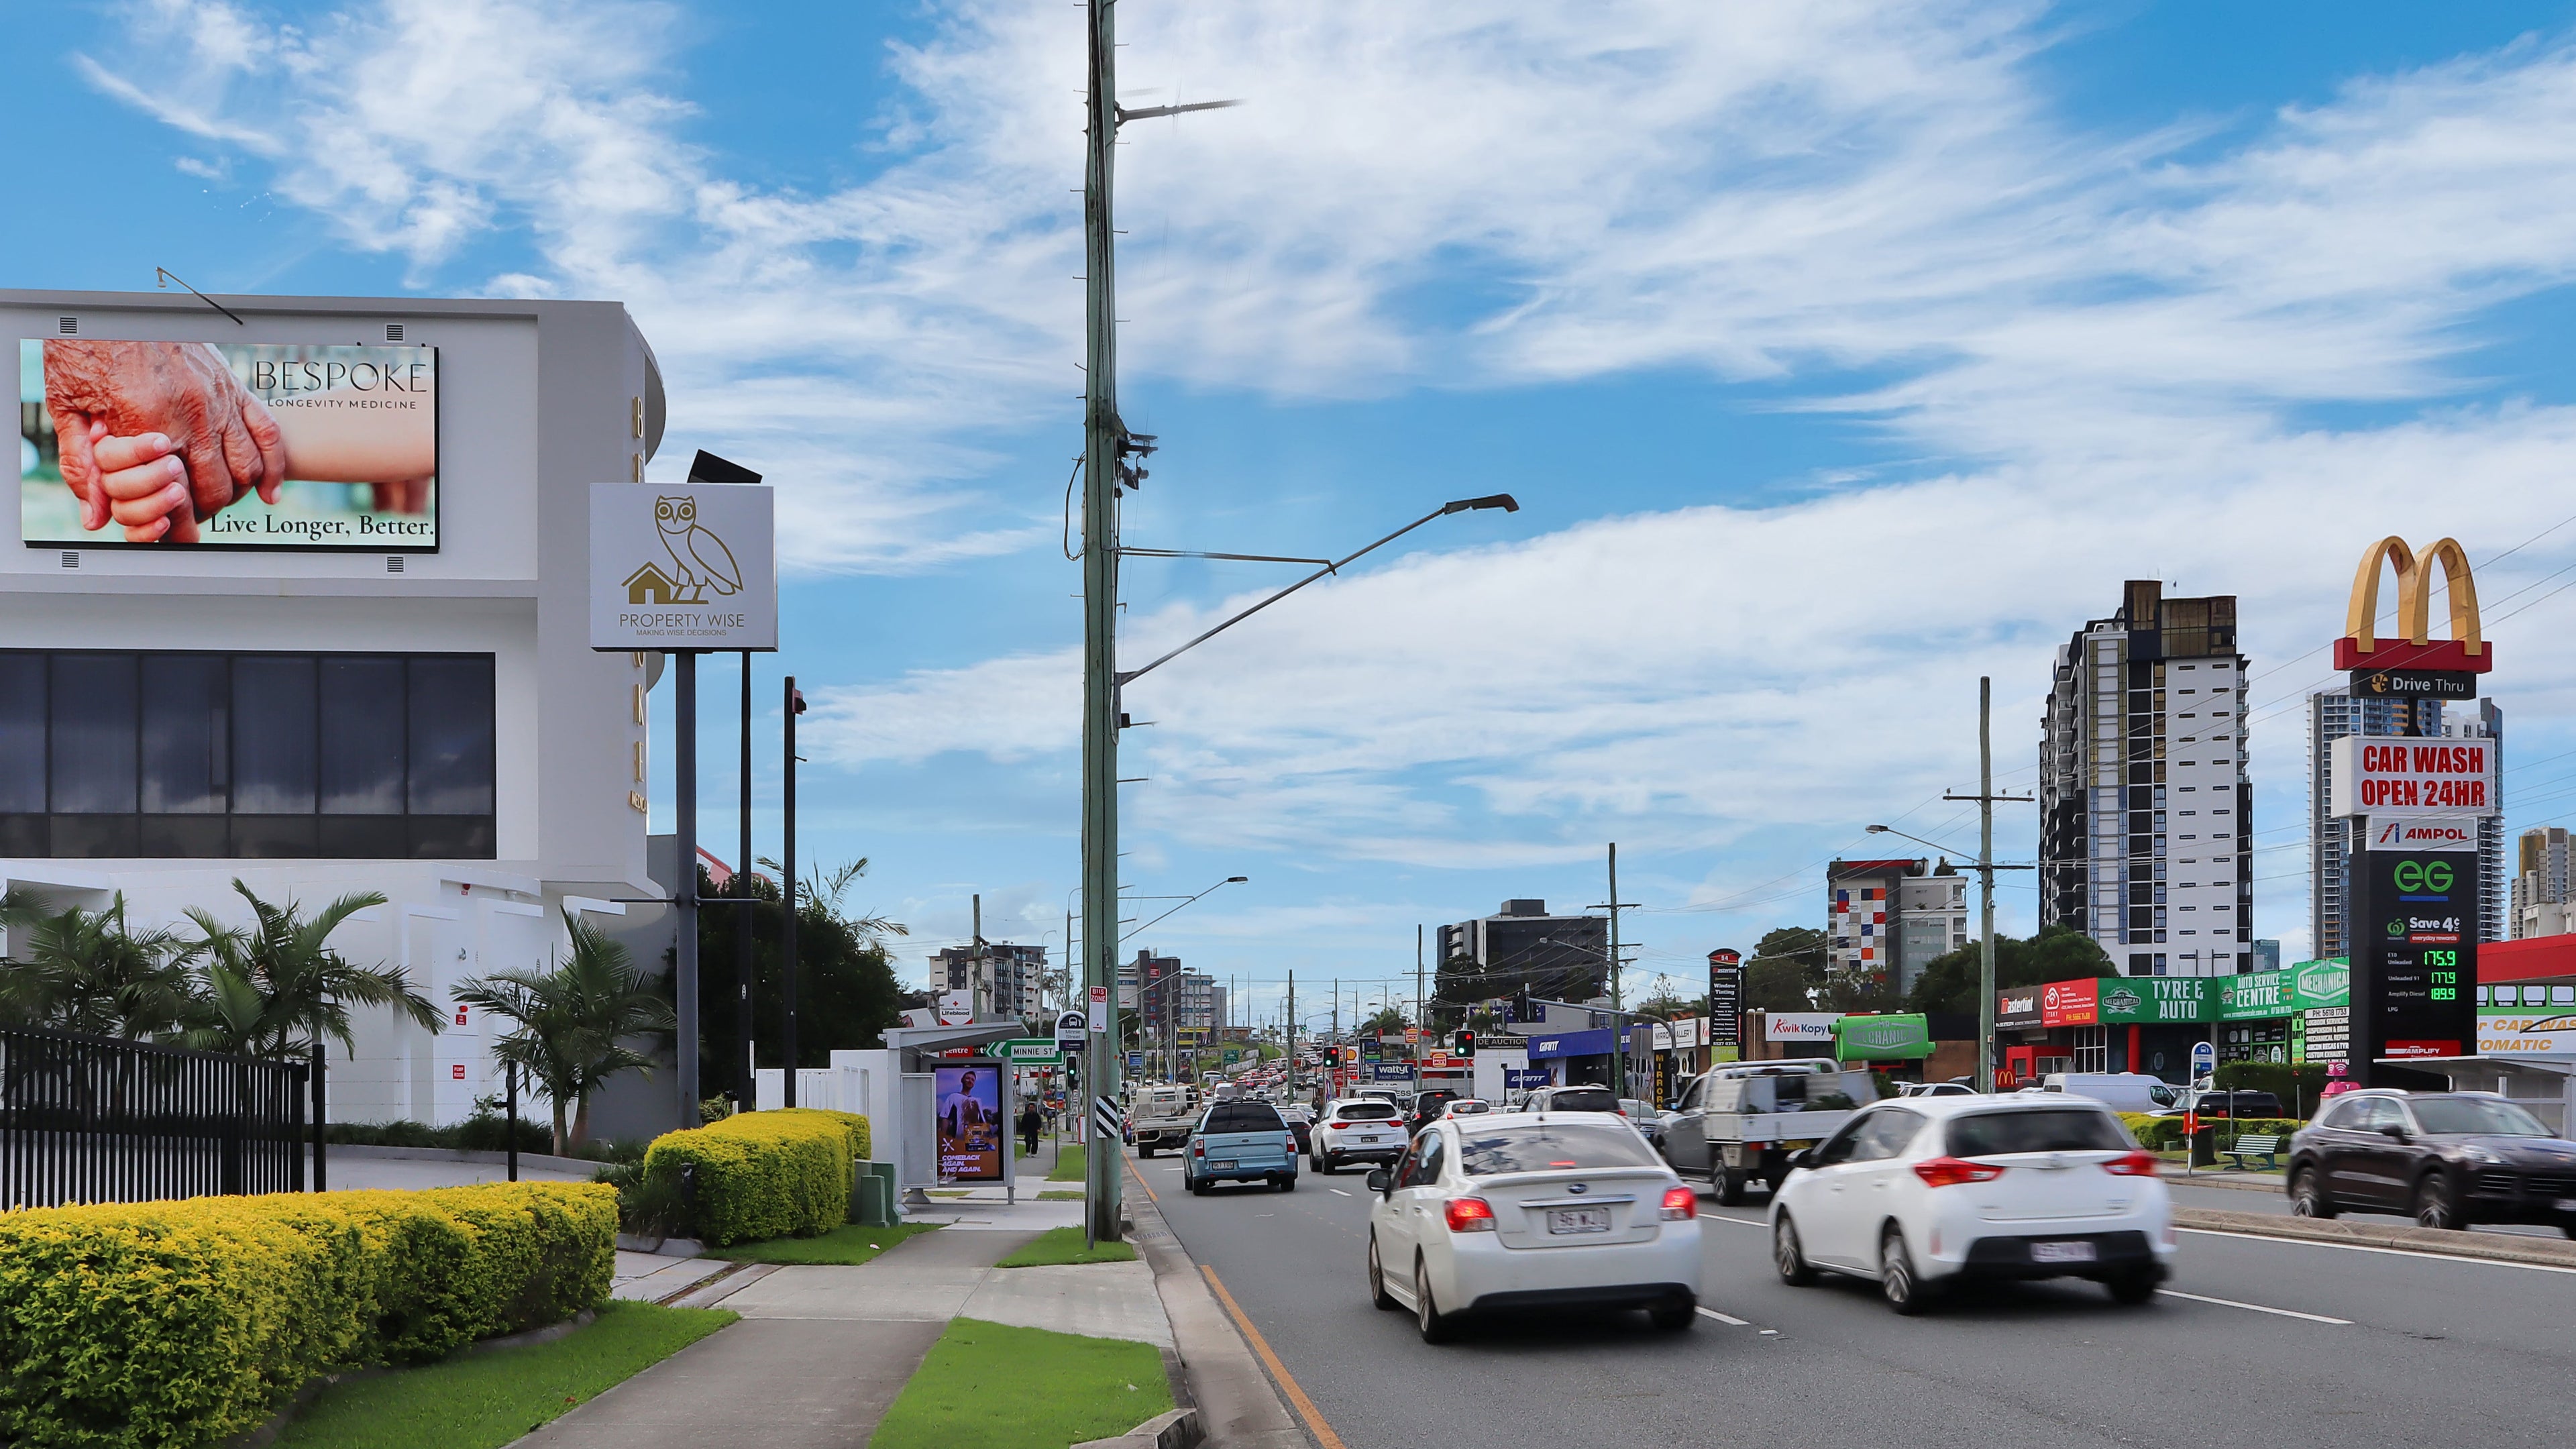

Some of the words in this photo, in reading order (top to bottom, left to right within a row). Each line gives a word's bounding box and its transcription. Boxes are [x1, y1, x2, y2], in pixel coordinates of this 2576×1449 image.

[256, 361, 427, 392] BESPOKE
[268, 398, 343, 408] LONGEVITY
[349, 400, 417, 409] MEDICINE
[210, 514, 258, 533] Live
[265, 514, 350, 541] Longer,
[358, 515, 434, 535] Better.
[619, 613, 701, 628] PROPERTY
[706, 613, 745, 628] WISE
[2392, 677, 2431, 692] Drive
[2434, 678, 2465, 692] Thru
[2363, 745, 2408, 772] CAR
[2413, 747, 2484, 773] WASH
[2361, 779, 2418, 806] OPEN
[2423, 780, 2485, 807] 24HR
[2404, 828, 2468, 840] AMPOL
[2409, 916, 2440, 929] Save
[2321, 960, 2330, 971] MR
[2424, 951, 2456, 966] 175.9
[2237, 976, 2253, 989] AUTO
[2254, 973, 2280, 987] SERVICE
[2151, 980, 2191, 1000] TYRE
[2194, 980, 2204, 1000] &
[2237, 985, 2280, 1008] CENTRE
[2431, 987, 2456, 1000] 189.9
[2104, 996, 2140, 1008] MECHANICAL
[2158, 1000, 2198, 1020] AUTO
[2539, 1019, 2576, 1030] WAS
[1655, 1032, 1670, 1040] MIRRO
[1676, 1029, 1692, 1038] ALLERY
[1539, 1040, 1560, 1053] GIANT
[1379, 1065, 1409, 1075] wattyl
